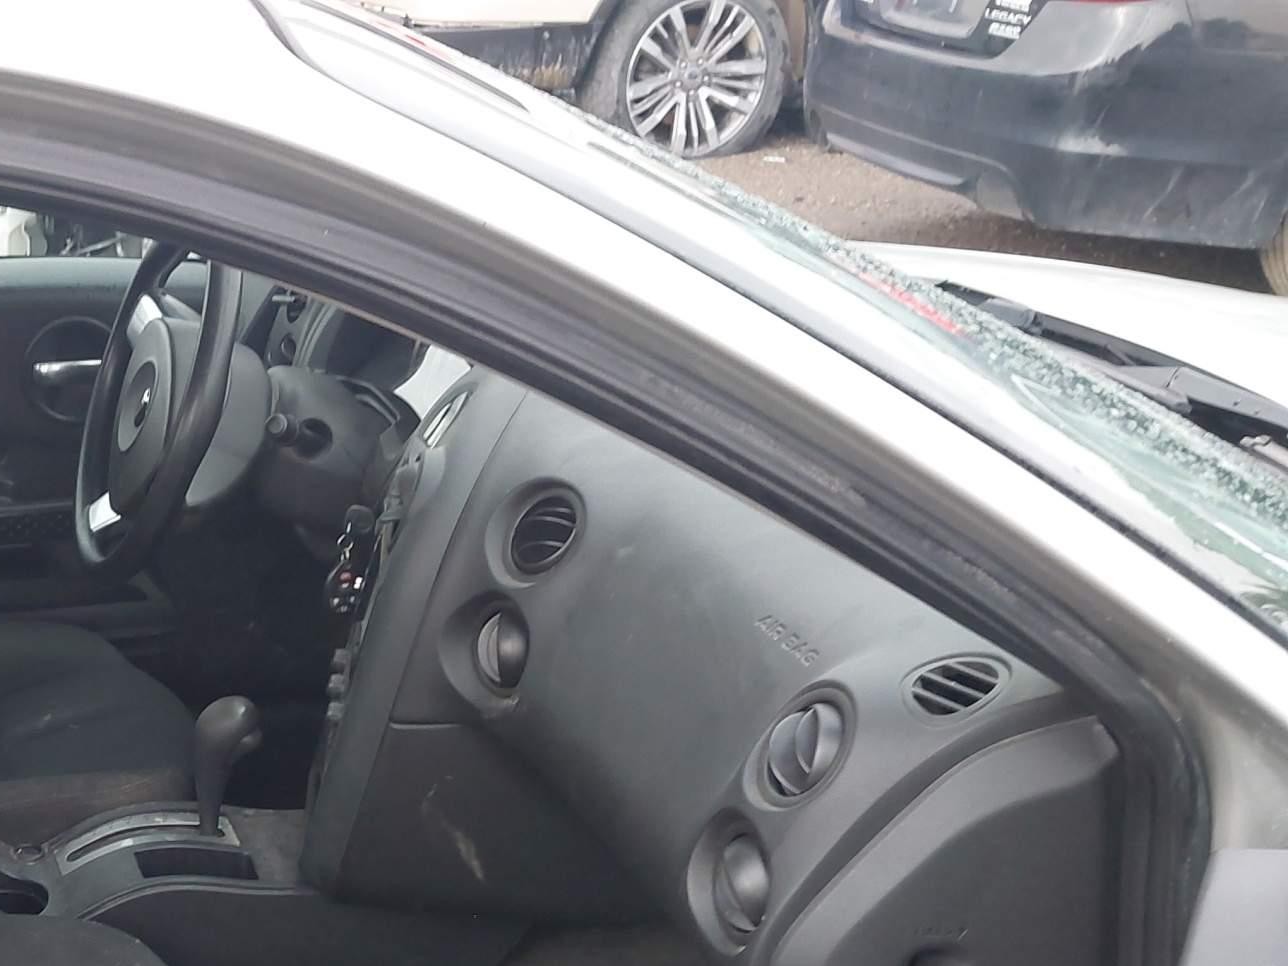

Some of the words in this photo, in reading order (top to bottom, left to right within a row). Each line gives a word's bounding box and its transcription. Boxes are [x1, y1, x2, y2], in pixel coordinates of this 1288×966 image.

[984, 7, 1032, 25] LEGACY
[754, 614, 787, 641] AIR
[781, 632, 821, 667] BAG
